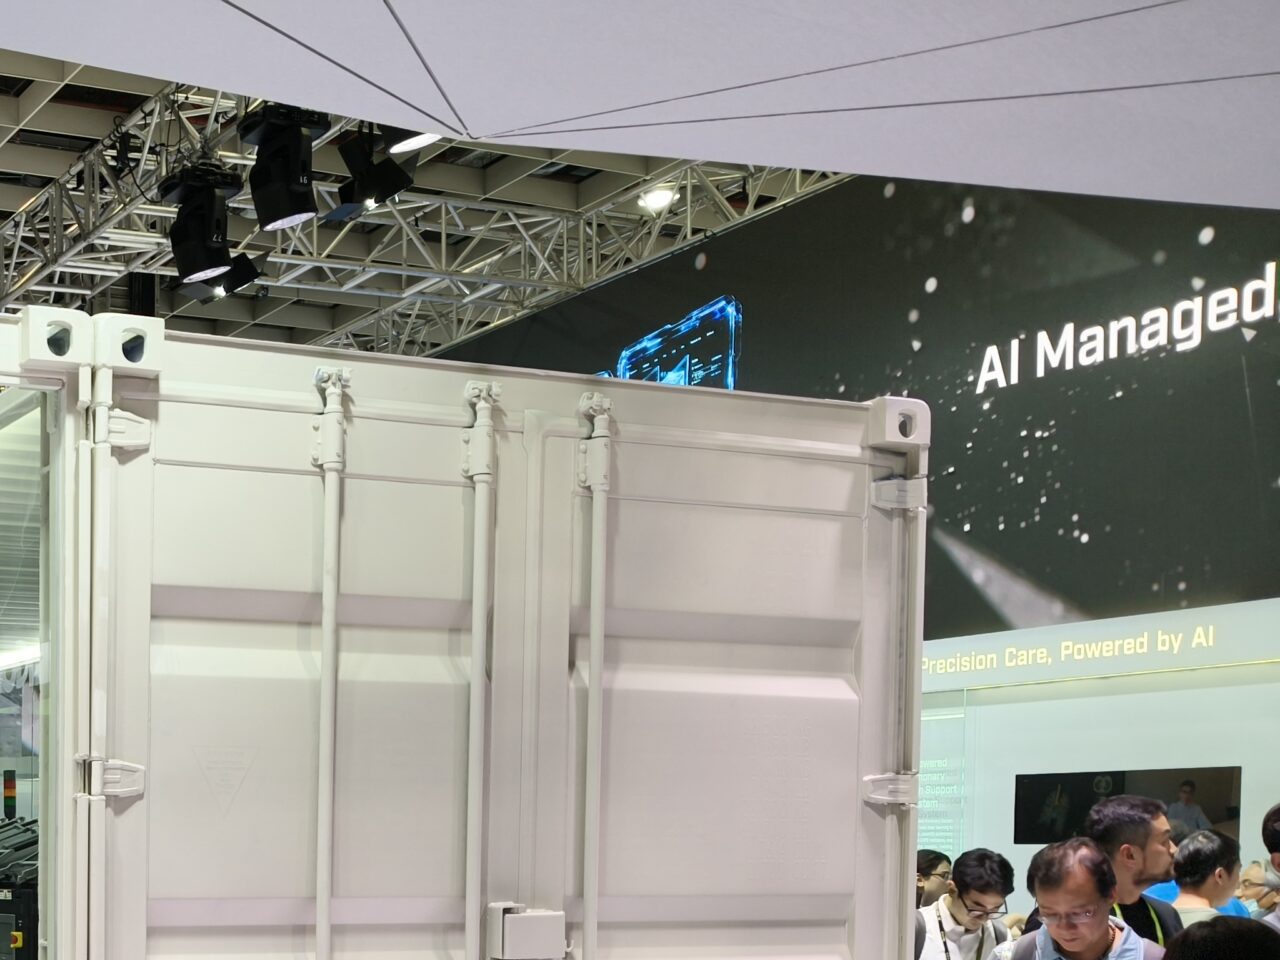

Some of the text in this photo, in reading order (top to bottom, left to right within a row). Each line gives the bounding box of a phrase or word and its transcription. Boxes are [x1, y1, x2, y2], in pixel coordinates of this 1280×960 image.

[974, 260, 1279, 396] AI Managed
[1004, 646, 1053, 668] Care,
[1060, 631, 1149, 662] Powered
[1157, 629, 1184, 655] by
[1191, 624, 1216, 649] AI
